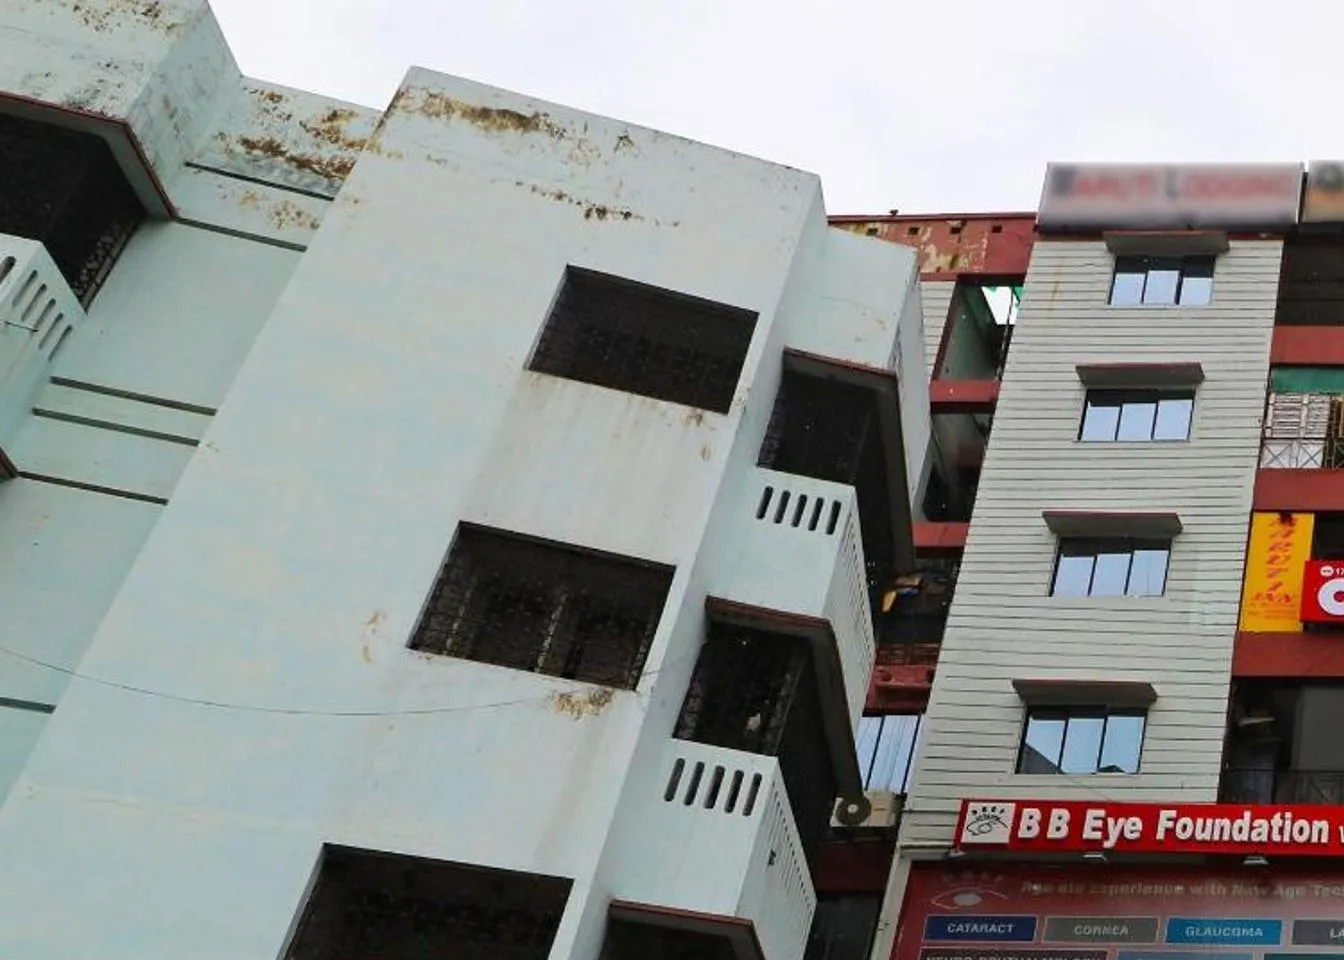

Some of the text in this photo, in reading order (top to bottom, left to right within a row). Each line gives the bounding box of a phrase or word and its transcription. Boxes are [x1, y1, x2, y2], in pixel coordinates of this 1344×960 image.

[1018, 808, 1042, 839] B
[1046, 808, 1070, 839] B
[1082, 809, 1143, 848] Eye
[1156, 809, 1330, 844] Foundation
[947, 922, 1014, 934] CATARACT
[1074, 923, 1129, 936] CORNEA
[1185, 925, 1264, 938] GLAUCOMA
